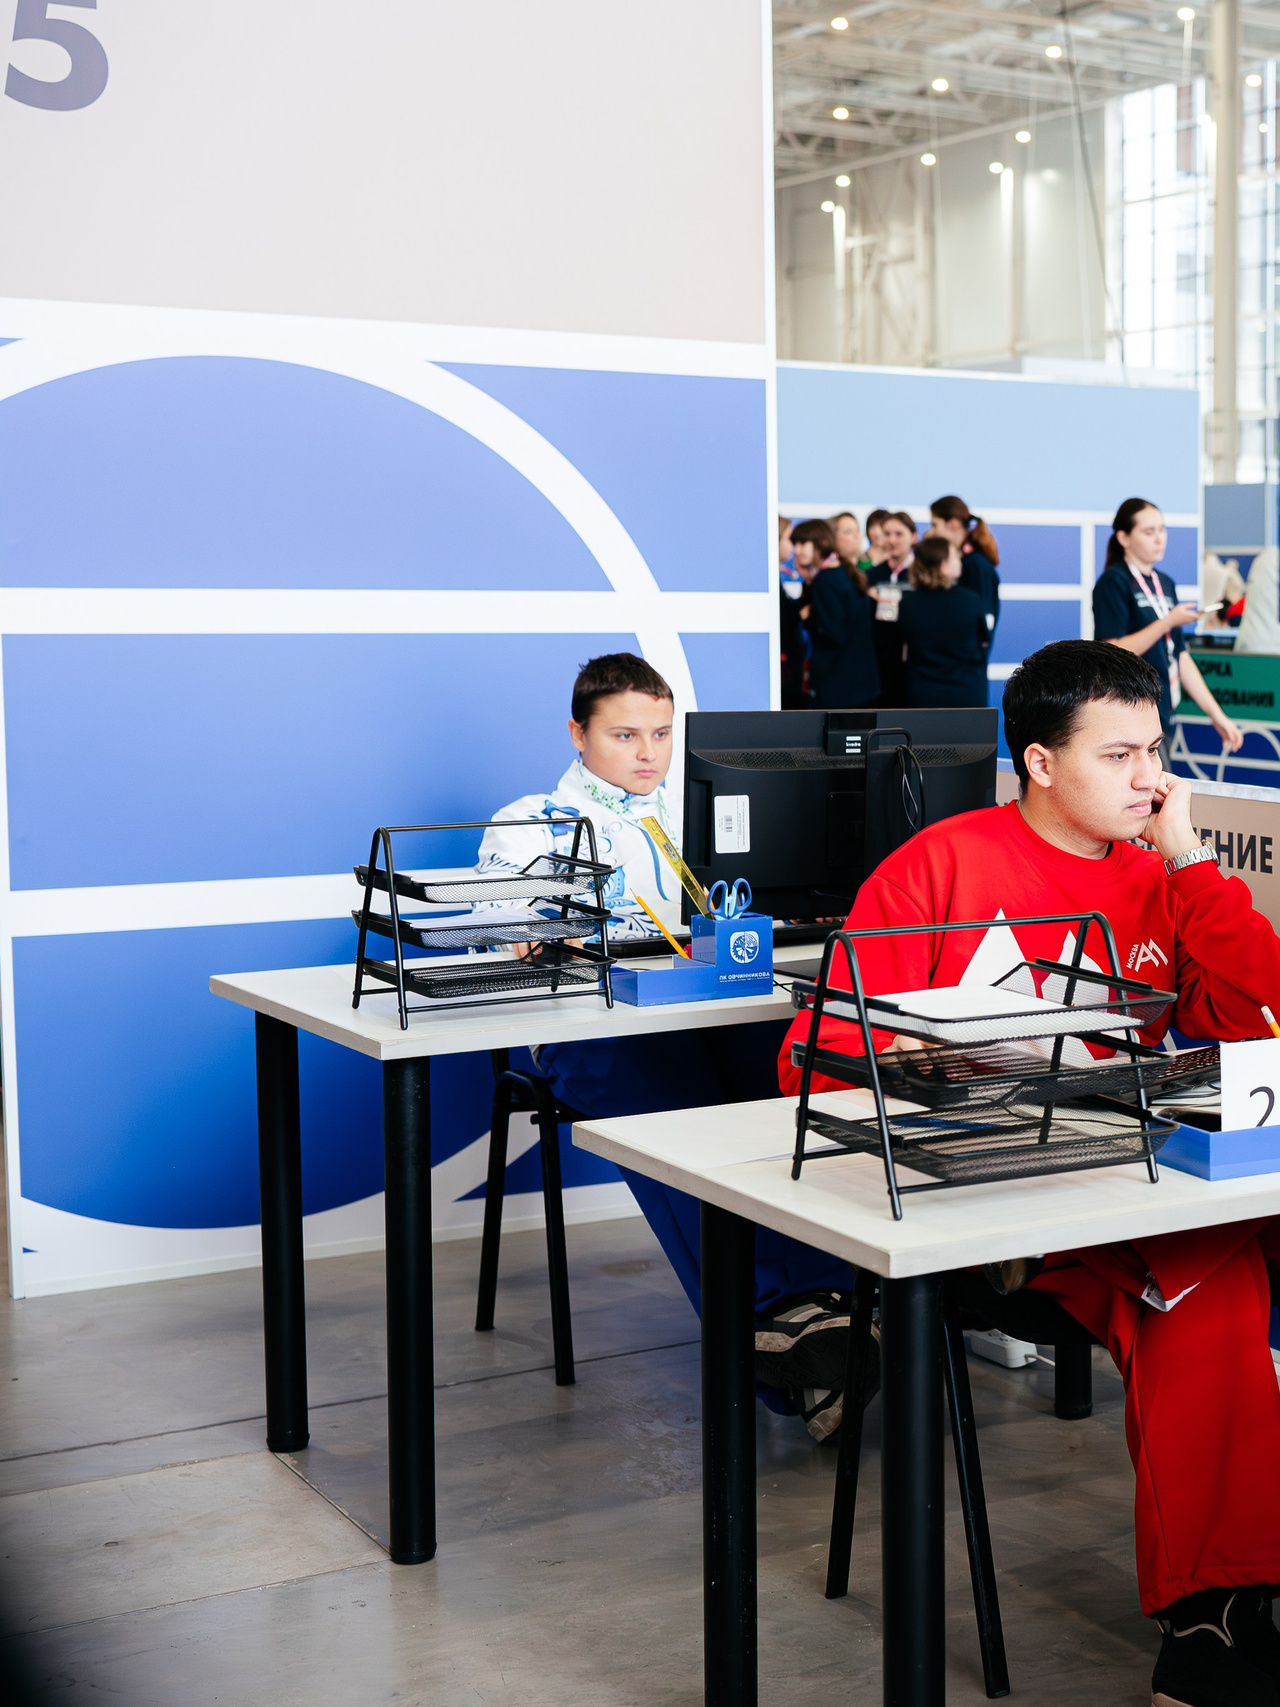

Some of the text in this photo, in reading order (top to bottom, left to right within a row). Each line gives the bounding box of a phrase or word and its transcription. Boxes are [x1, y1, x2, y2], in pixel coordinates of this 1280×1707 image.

[4, 0, 109, 112] 5
[1126, 944, 1140, 969] МОСКВА
[1250, 1085, 1275, 1127] 2
